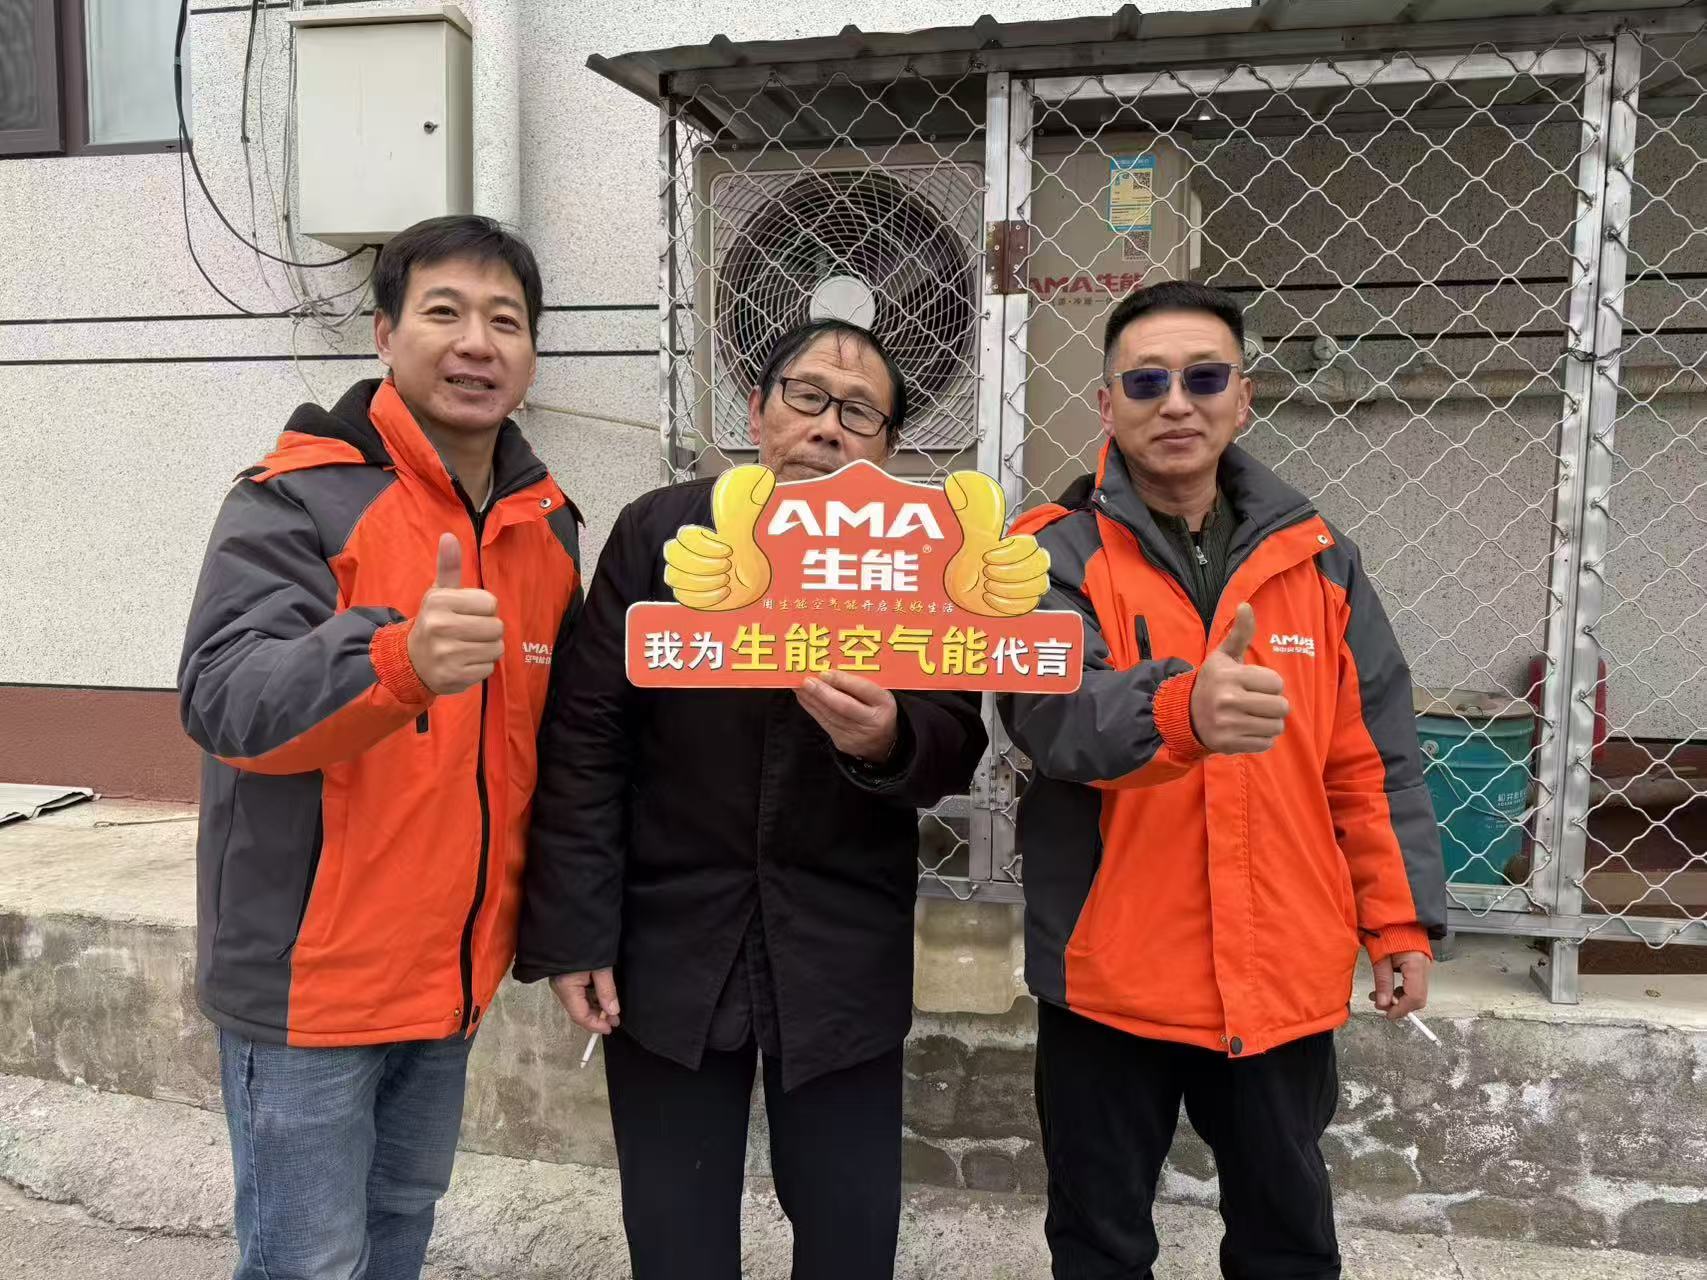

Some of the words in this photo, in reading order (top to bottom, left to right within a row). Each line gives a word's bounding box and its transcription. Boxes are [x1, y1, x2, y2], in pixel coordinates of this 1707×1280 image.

[767, 499, 945, 539] AMA
[801, 547, 919, 592] 生能
[644, 622, 1073, 677] 我为生能空气能代言
